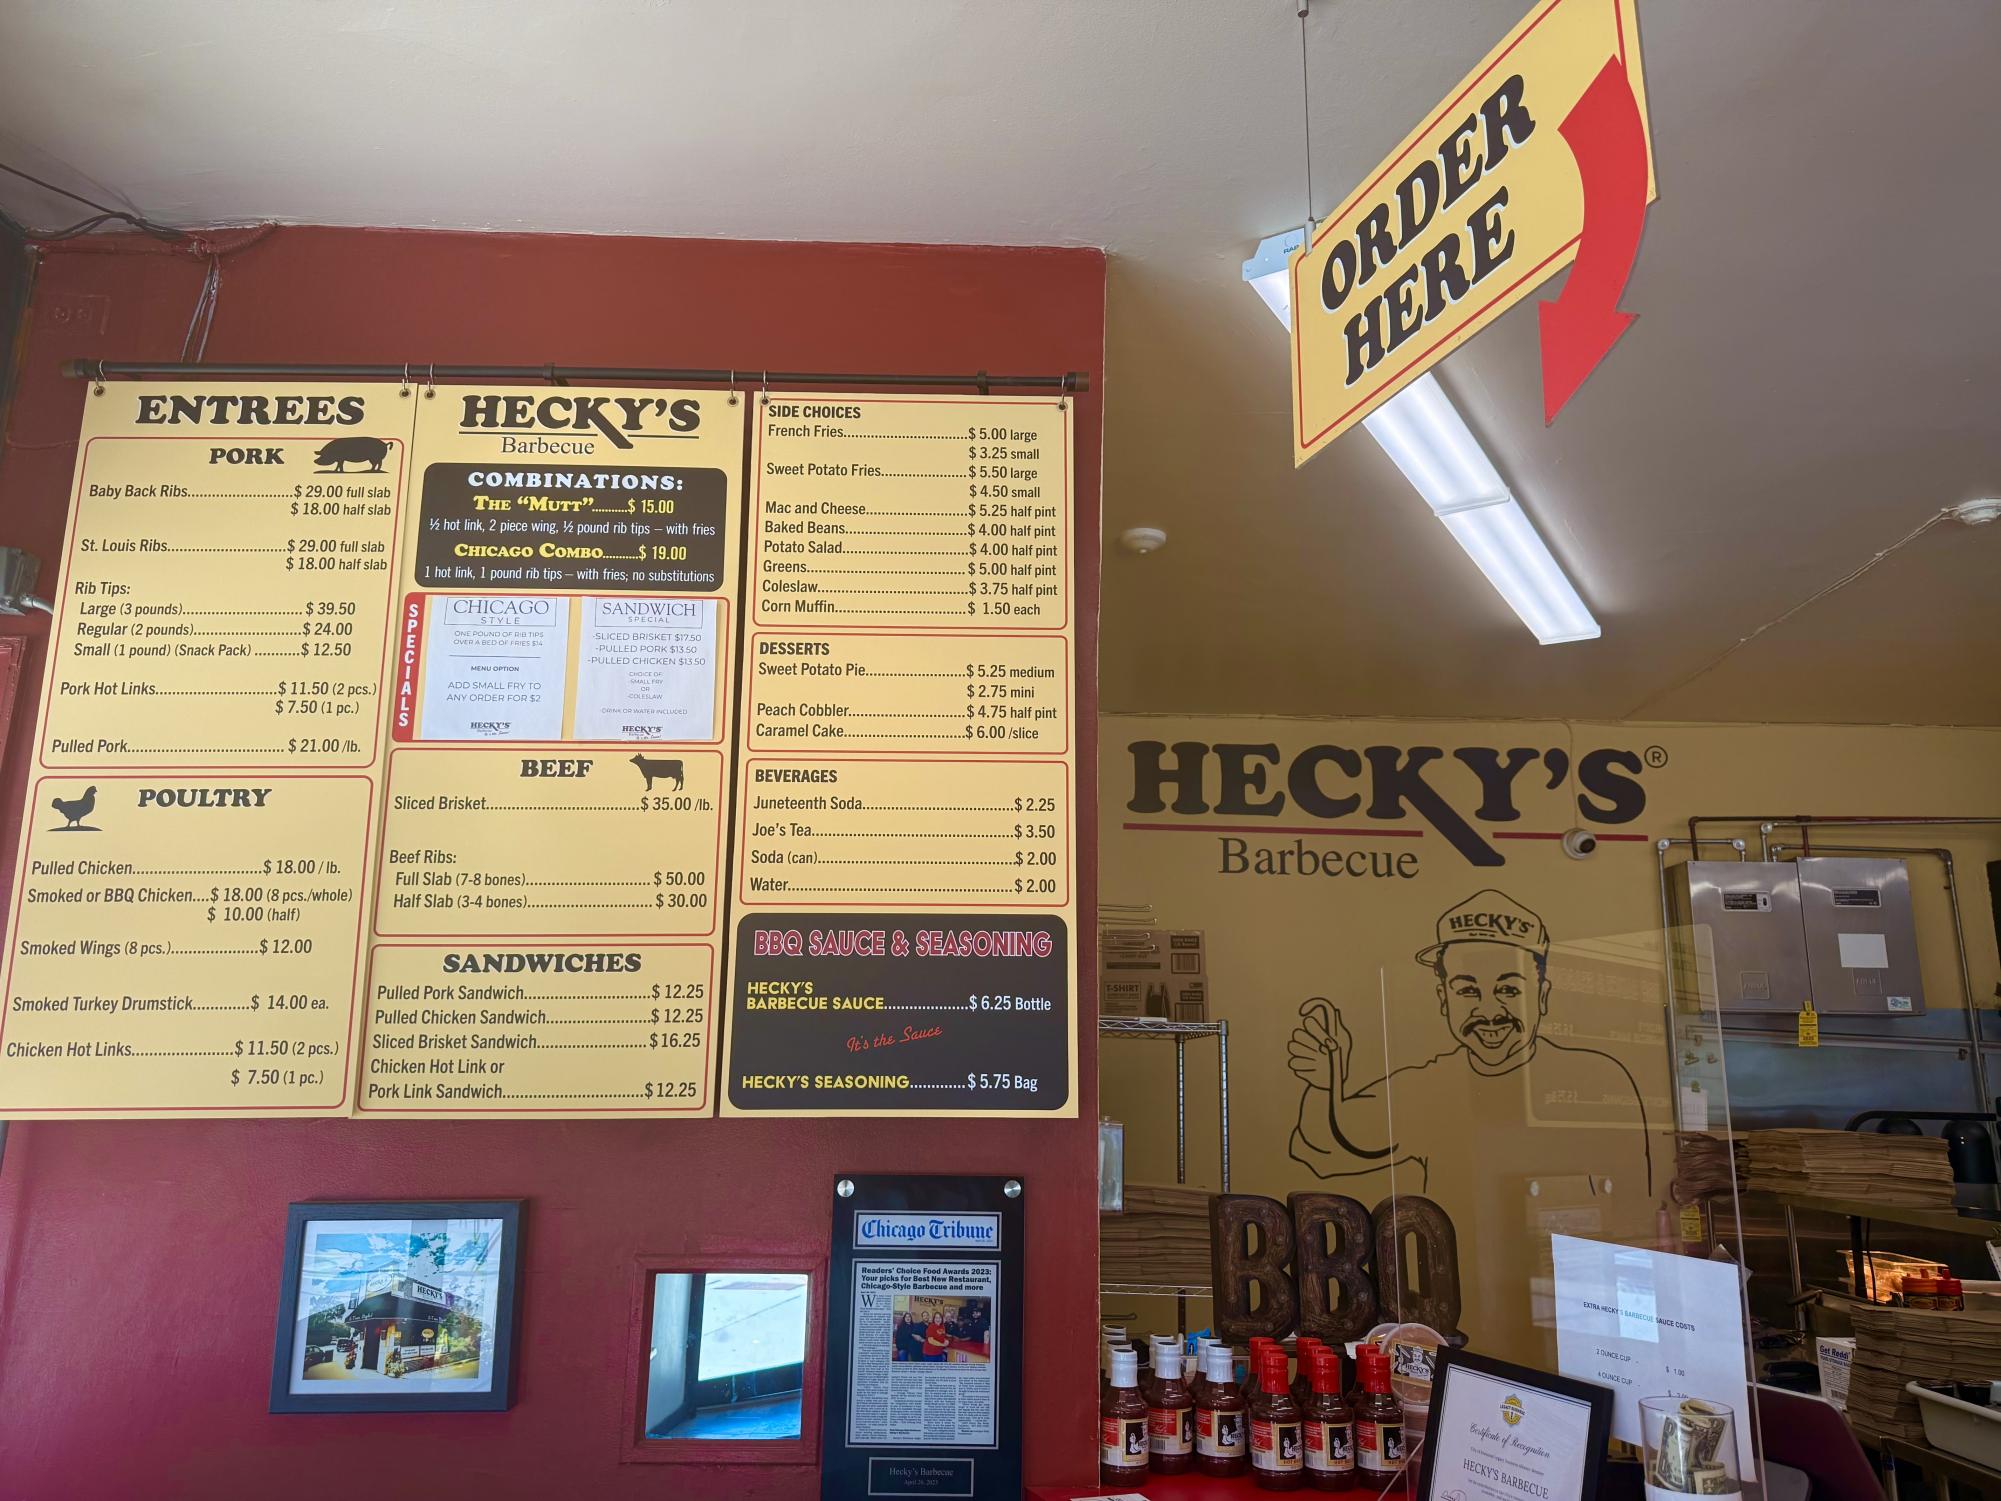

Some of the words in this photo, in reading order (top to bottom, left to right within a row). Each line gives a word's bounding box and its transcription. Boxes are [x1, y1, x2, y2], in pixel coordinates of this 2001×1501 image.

[1321, 73, 1536, 313] ORDER
[1342, 185, 1515, 388] HERE
[135, 395, 365, 425] ENTREES
[768, 406, 799, 418] SIDE
[803, 406, 860, 419] CHOICES
[459, 395, 701, 449] HECKY'S
[768, 424, 810, 437] French
[1010, 429, 1037, 443] large
[502, 437, 595, 454] Barbecue
[209, 447, 284, 465] PORK
[1010, 448, 1039, 460] small
[767, 463, 804, 476] Sweet
[808, 464, 847, 476] Potato
[468, 472, 683, 491] COMBINATIONS:
[89, 485, 122, 500] Baby
[125, 485, 157, 497] Back
[346, 486, 364, 498] full
[367, 487, 390, 498] slab
[1010, 505, 1031, 517] half
[1034, 505, 1056, 520] pint
[443, 519, 460, 531] hot
[462, 520, 485, 532] link,
[500, 520, 527, 535] piece
[530, 520, 559, 535] wing,
[578, 521, 610, 537] pound
[613, 522, 627, 534] rib
[629, 522, 650, 537] tips
[666, 523, 688, 535] with
[692, 524, 715, 536] fries
[81, 539, 98, 553] St.
[102, 539, 136, 553] Louis
[435, 566, 452, 579] hot
[454, 566, 477, 581] link,
[490, 568, 522, 582] pound
[525, 568, 539, 581] rib
[542, 569, 562, 583] tips
[576, 568, 599, 581] with
[602, 569, 629, 582] fries;
[632, 572, 645, 582] no
[648, 570, 714, 582] substitutions
[75, 582, 96, 596] Rib
[101, 582, 131, 598] Tips:
[454, 600, 549, 614] CHICAGO
[602, 602, 696, 616] SANDWICH
[632, 633, 672, 641] BRISKET
[760, 642, 830, 656] DESSERTS
[632, 657, 676, 665] CHICKEN
[678, 658, 705, 666] $13.50
[1009, 666, 1055, 678] medium
[472, 682, 504, 690] SMALL
[508, 682, 525, 690] FRY
[469, 694, 504, 702] ORDER
[530, 694, 541, 702] $2
[470, 722, 510, 731] HECKY'S
[520, 760, 593, 778] BEEF
[755, 770, 837, 783] BEVERAGES
[138, 788, 272, 808] POULTRY
[754, 797, 826, 811] Juneteenth
[1126, 740, 1646, 866] HECKY'S
[390, 850, 421, 864] Beef
[424, 851, 457, 864] Ribs:
[1218, 837, 1420, 879] Barbecue
[28, 888, 82, 903] Smoked
[86, 892, 100, 903] or
[104, 889, 134, 904] BBQ
[1449, 913, 1529, 936] HECKY'S
[754, 930, 803, 956] BBQ
[808, 930, 885, 956] SAUCE
[891, 930, 909, 956] &
[916, 931, 1052, 957] SEASONING
[443, 953, 642, 973] SANDWICHES
[747, 982, 813, 995] HECKY'S
[1106, 984, 1139, 992] T-SHIRT
[747, 997, 828, 1010] BARBECUE
[1015, 997, 1051, 1011] Bottle
[874, 1034, 895, 1048] the
[900, 1025, 943, 1044] Sauce
[371, 1059, 425, 1073] Chicken
[429, 1059, 454, 1073] Hot
[458, 1059, 486, 1073] Link
[490, 1062, 504, 1073] or
[742, 1076, 809, 1089] HECKY'S
[1014, 1075, 1038, 1091] Bag
[862, 1219, 925, 1240] Chicago
[929, 1220, 993, 1239] Tribune
[1209, 1191, 1469, 1348] BBQ
[1584, 1302, 1600, 1310] EXTRA
[1656, 1318, 1674, 1326] SAUCE
[1676, 1321, 1695, 1331] COSTS
[1463, 1458, 1499, 1481] HECKY'S
[1501, 1474, 1548, 1500] BARBECUE
